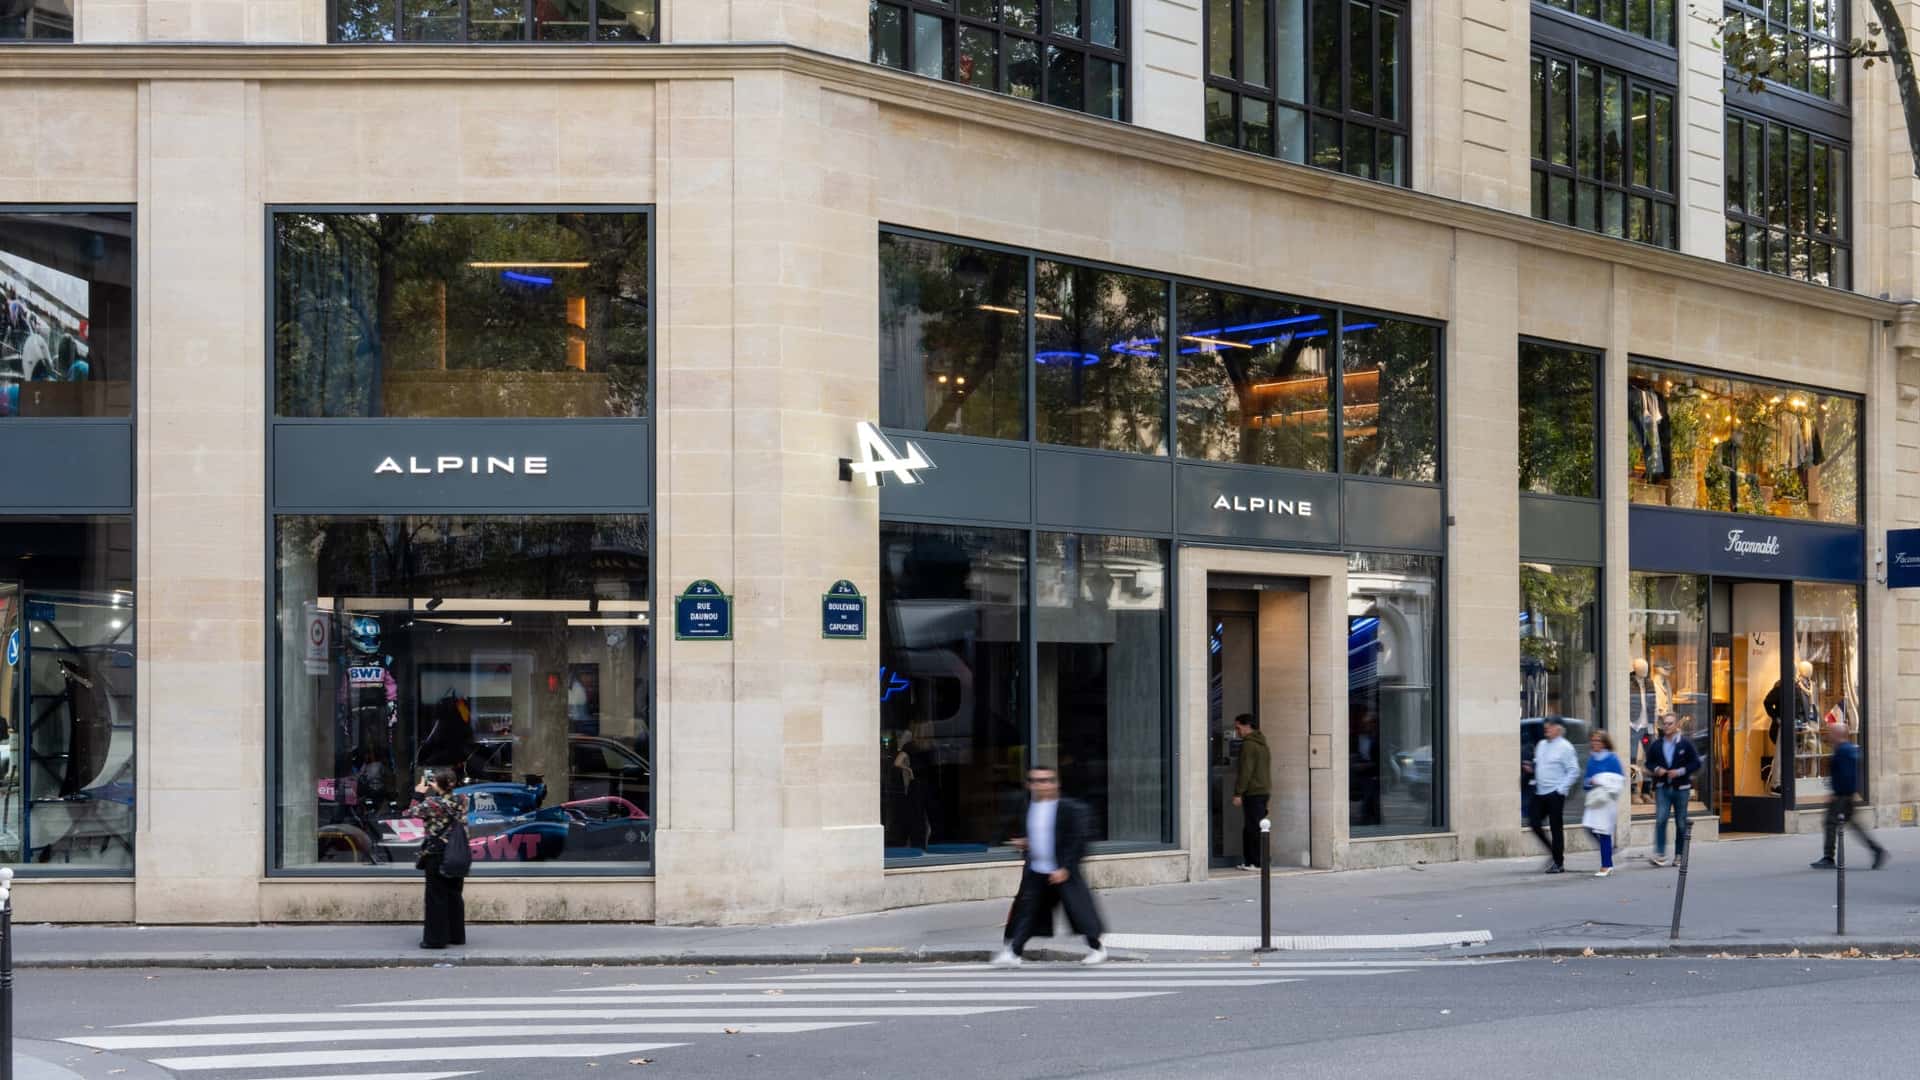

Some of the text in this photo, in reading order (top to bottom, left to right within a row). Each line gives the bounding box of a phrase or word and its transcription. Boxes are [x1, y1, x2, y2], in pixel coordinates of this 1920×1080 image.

[374, 456, 548, 474] ALPINE
[1213, 494, 1312, 516] ALPINE
[1725, 529, 1780, 556] Façonnable
[697, 602, 711, 610] RUE
[828, 603, 860, 611] BOULEVARD
[829, 623, 859, 631] CAPUCINES
[350, 668, 381, 679] BWT
[468, 833, 542, 859] BWT
